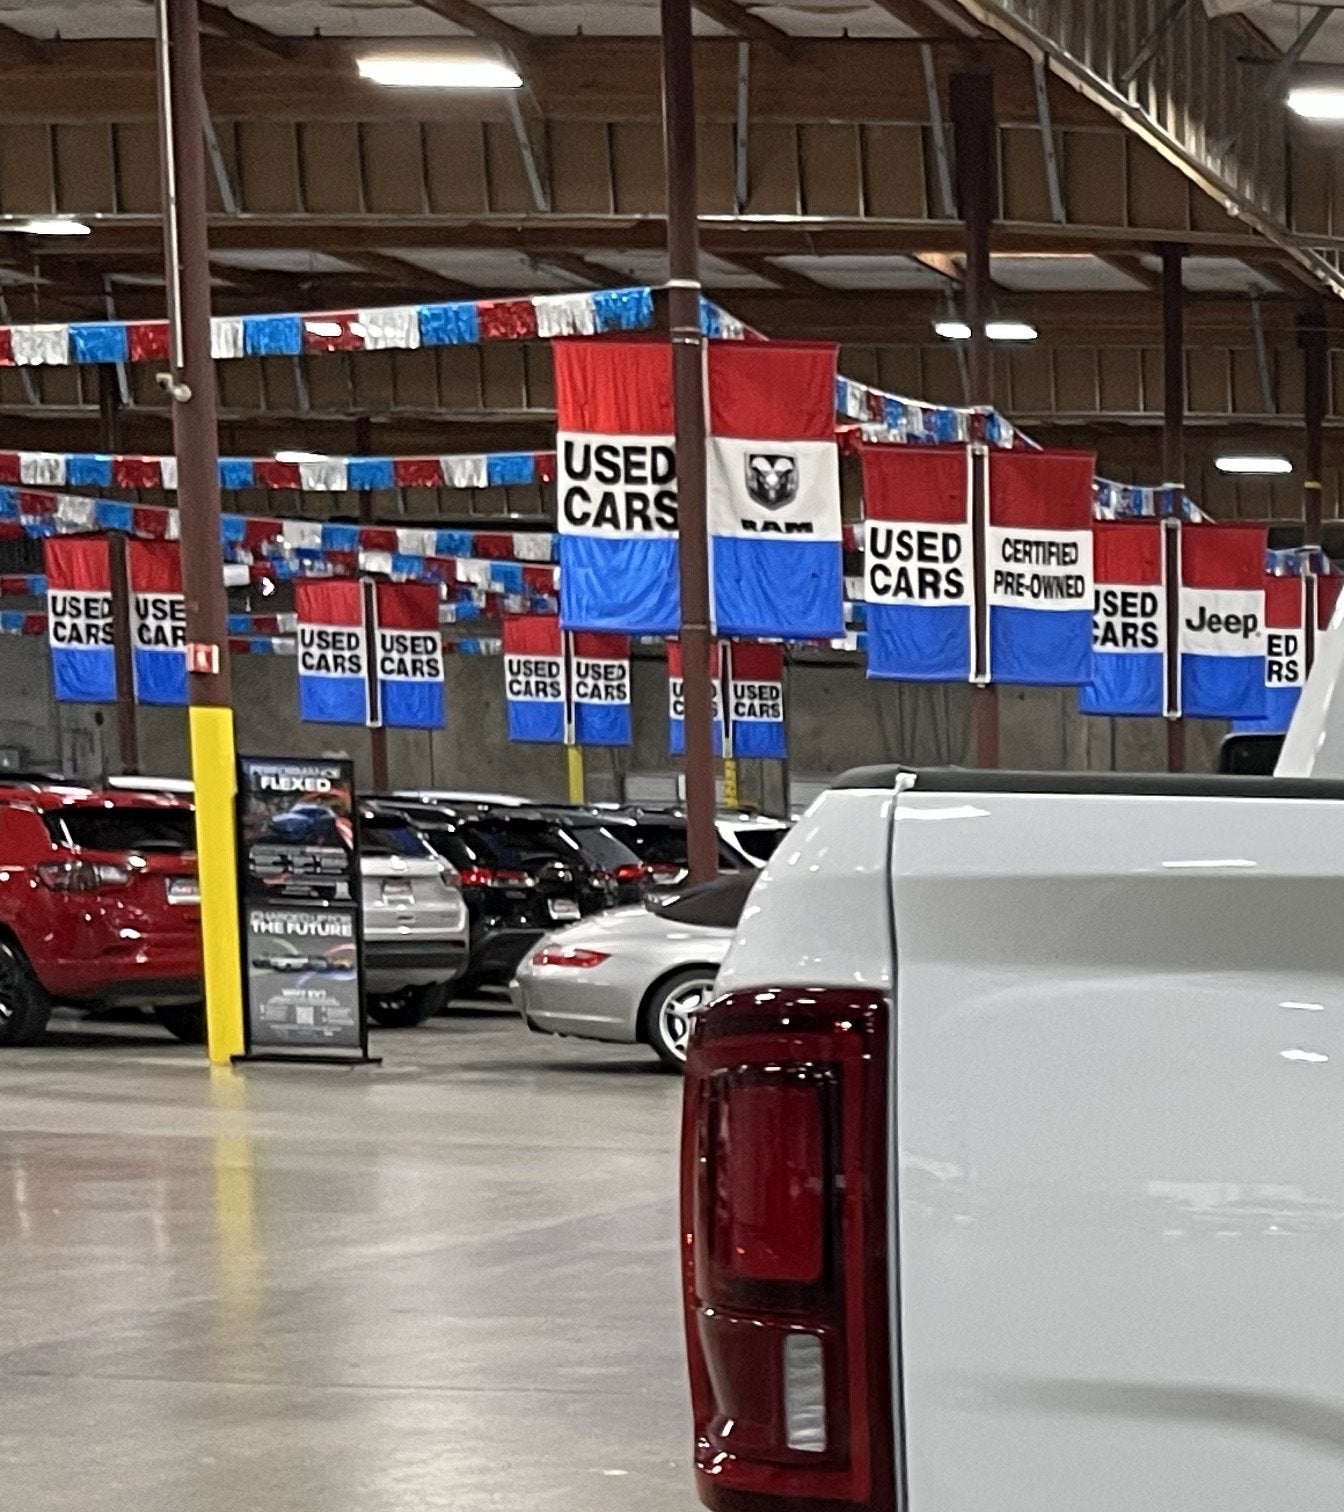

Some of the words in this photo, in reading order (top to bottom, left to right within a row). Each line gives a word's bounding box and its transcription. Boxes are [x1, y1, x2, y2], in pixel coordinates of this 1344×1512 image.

[564, 441, 677, 485] USED
[564, 486, 678, 531] CARS
[870, 527, 962, 563] USED
[1001, 537, 1079, 566] CERTIFIED
[870, 563, 965, 600] CARS
[993, 569, 1086, 599] PRE-OWNED
[51, 596, 113, 619] USED
[135, 597, 187, 621] USE
[53, 621, 115, 645] CARS
[1185, 606, 1258, 639] Jeep
[137, 622, 187, 647] CAR
[301, 628, 361, 651] USED
[381, 633, 437, 655] USED
[1267, 634, 1298, 657] ED
[302, 651, 362, 675] CARS
[380, 656, 440, 678] CARS
[509, 659, 560, 679] USED
[576, 661, 626, 682] USED
[1267, 660, 1299, 682] RS
[508, 679, 561, 699] CARS
[576, 681, 627, 701] CARS
[733, 684, 780, 701] USED
[734, 702, 780, 718] CARS
[260, 776, 332, 793] FLEXED
[251, 920, 284, 935] THE
[286, 921, 352, 937] FUTURE
